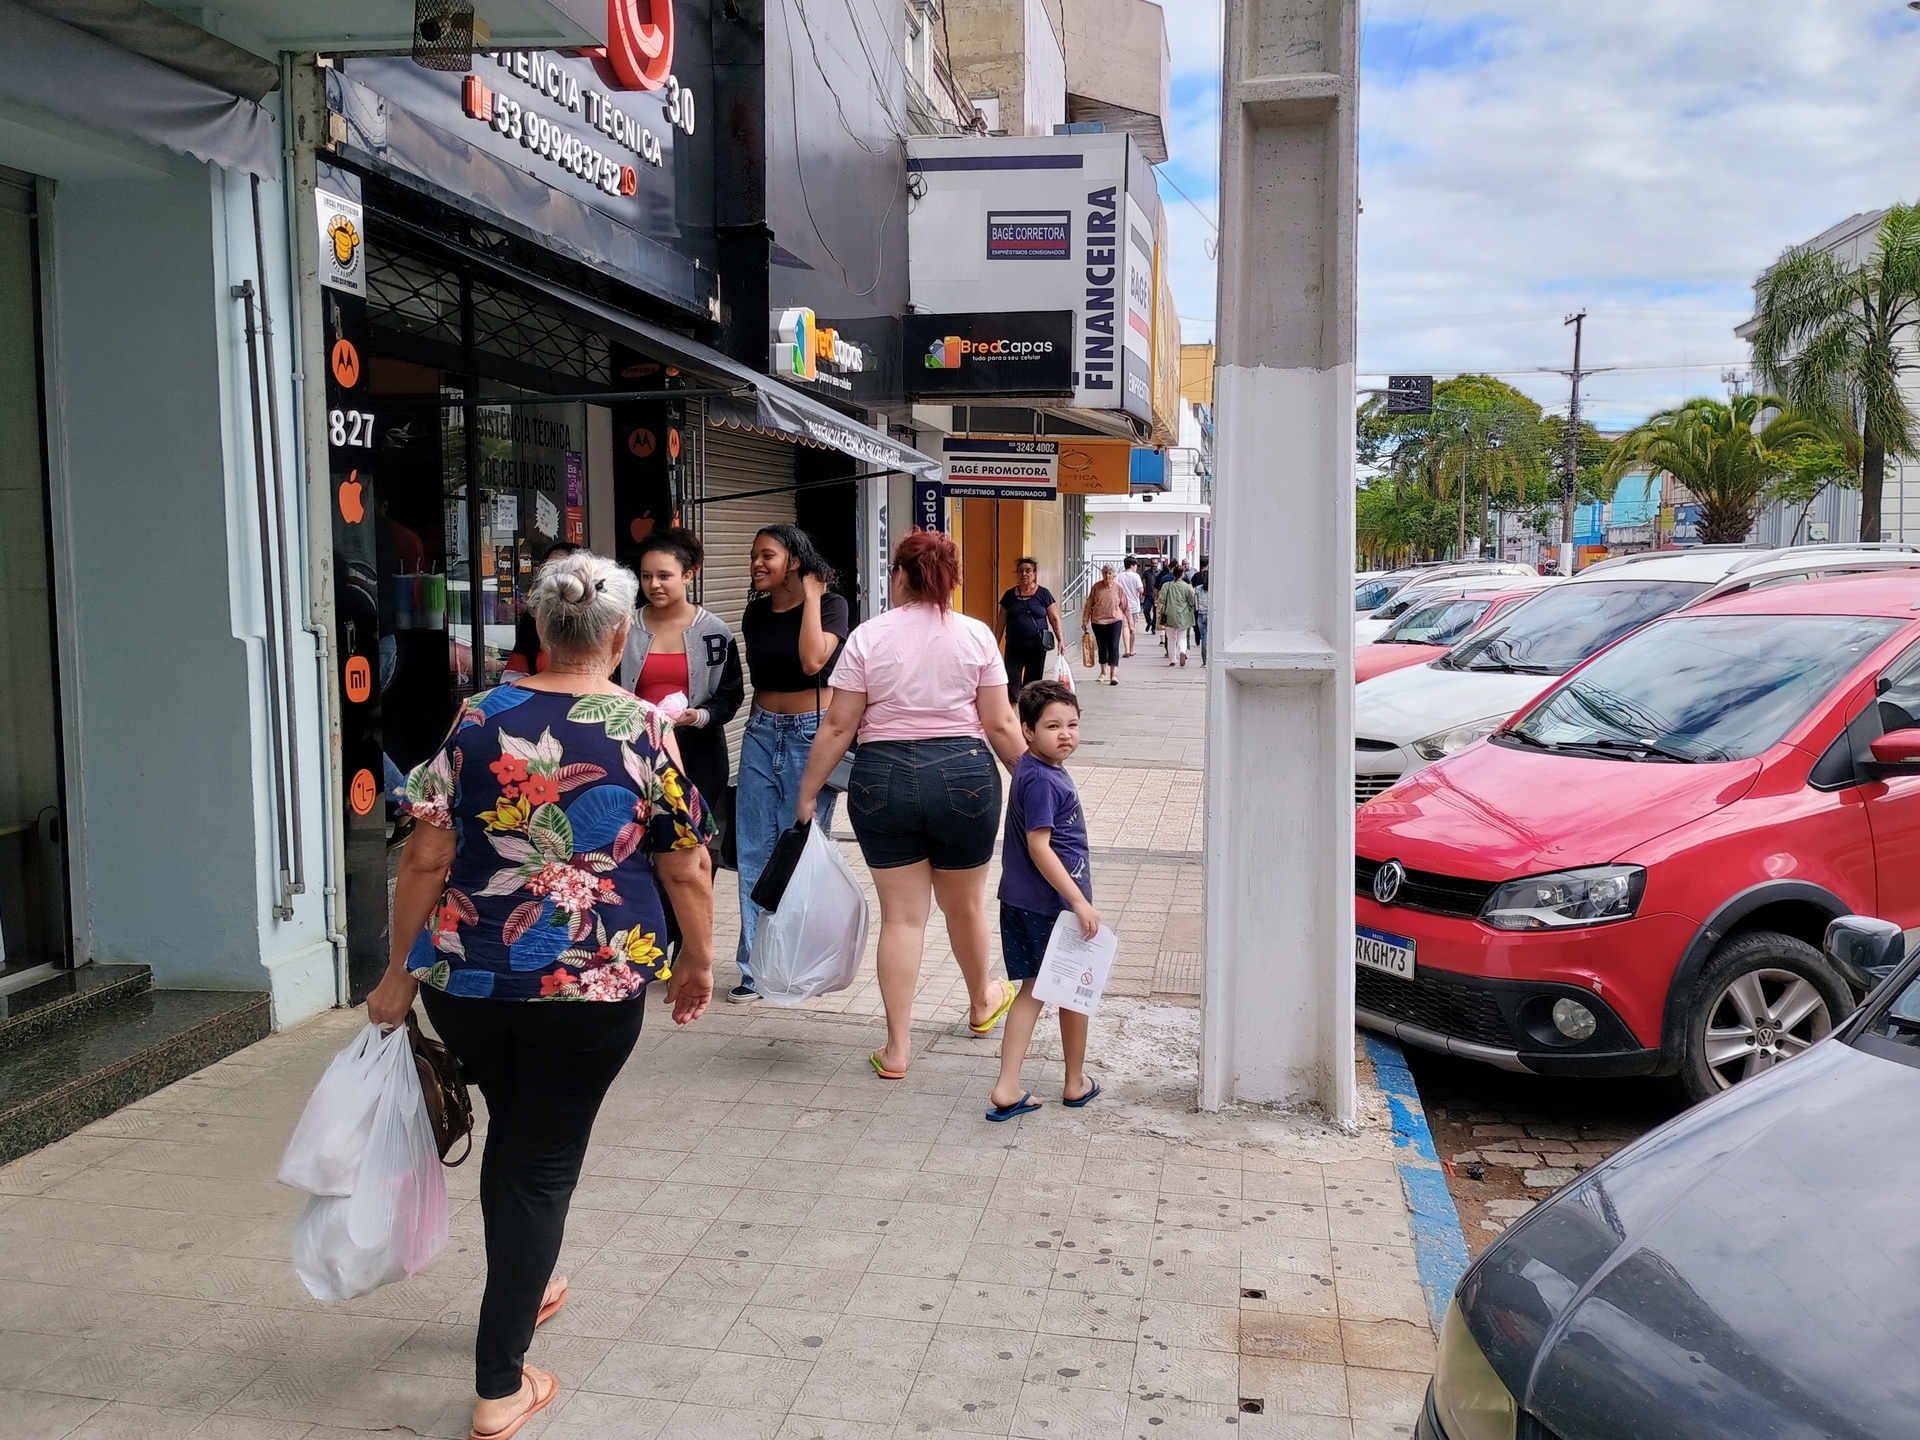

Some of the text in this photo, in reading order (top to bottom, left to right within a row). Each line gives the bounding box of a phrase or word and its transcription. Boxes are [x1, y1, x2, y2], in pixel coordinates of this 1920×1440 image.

[667, 74, 695, 136] 3.0
[496, 92, 622, 197] 53 999483752
[589, 90, 663, 168] TÉCNICA
[992, 225, 1066, 240] BAGÉ CORRETORA
[1084, 186, 1117, 390] FINANCEIRA
[1130, 266, 1149, 310] BAGÉ
[960, 338, 1053, 356] BredCapas
[328, 409, 375, 448] 827
[532, 414, 571, 452] TÉCNICA
[1016, 442, 1035, 452] 3242
[1036, 443, 1055, 453] 4002
[500, 459, 556, 492] CELULARES
[951, 463, 1048, 476] BAGÉ PROMOTORA
[950, 487, 1047, 498] EMPRÉSTIMOS CONSIGNADOS
[702, 633, 728, 667] B
